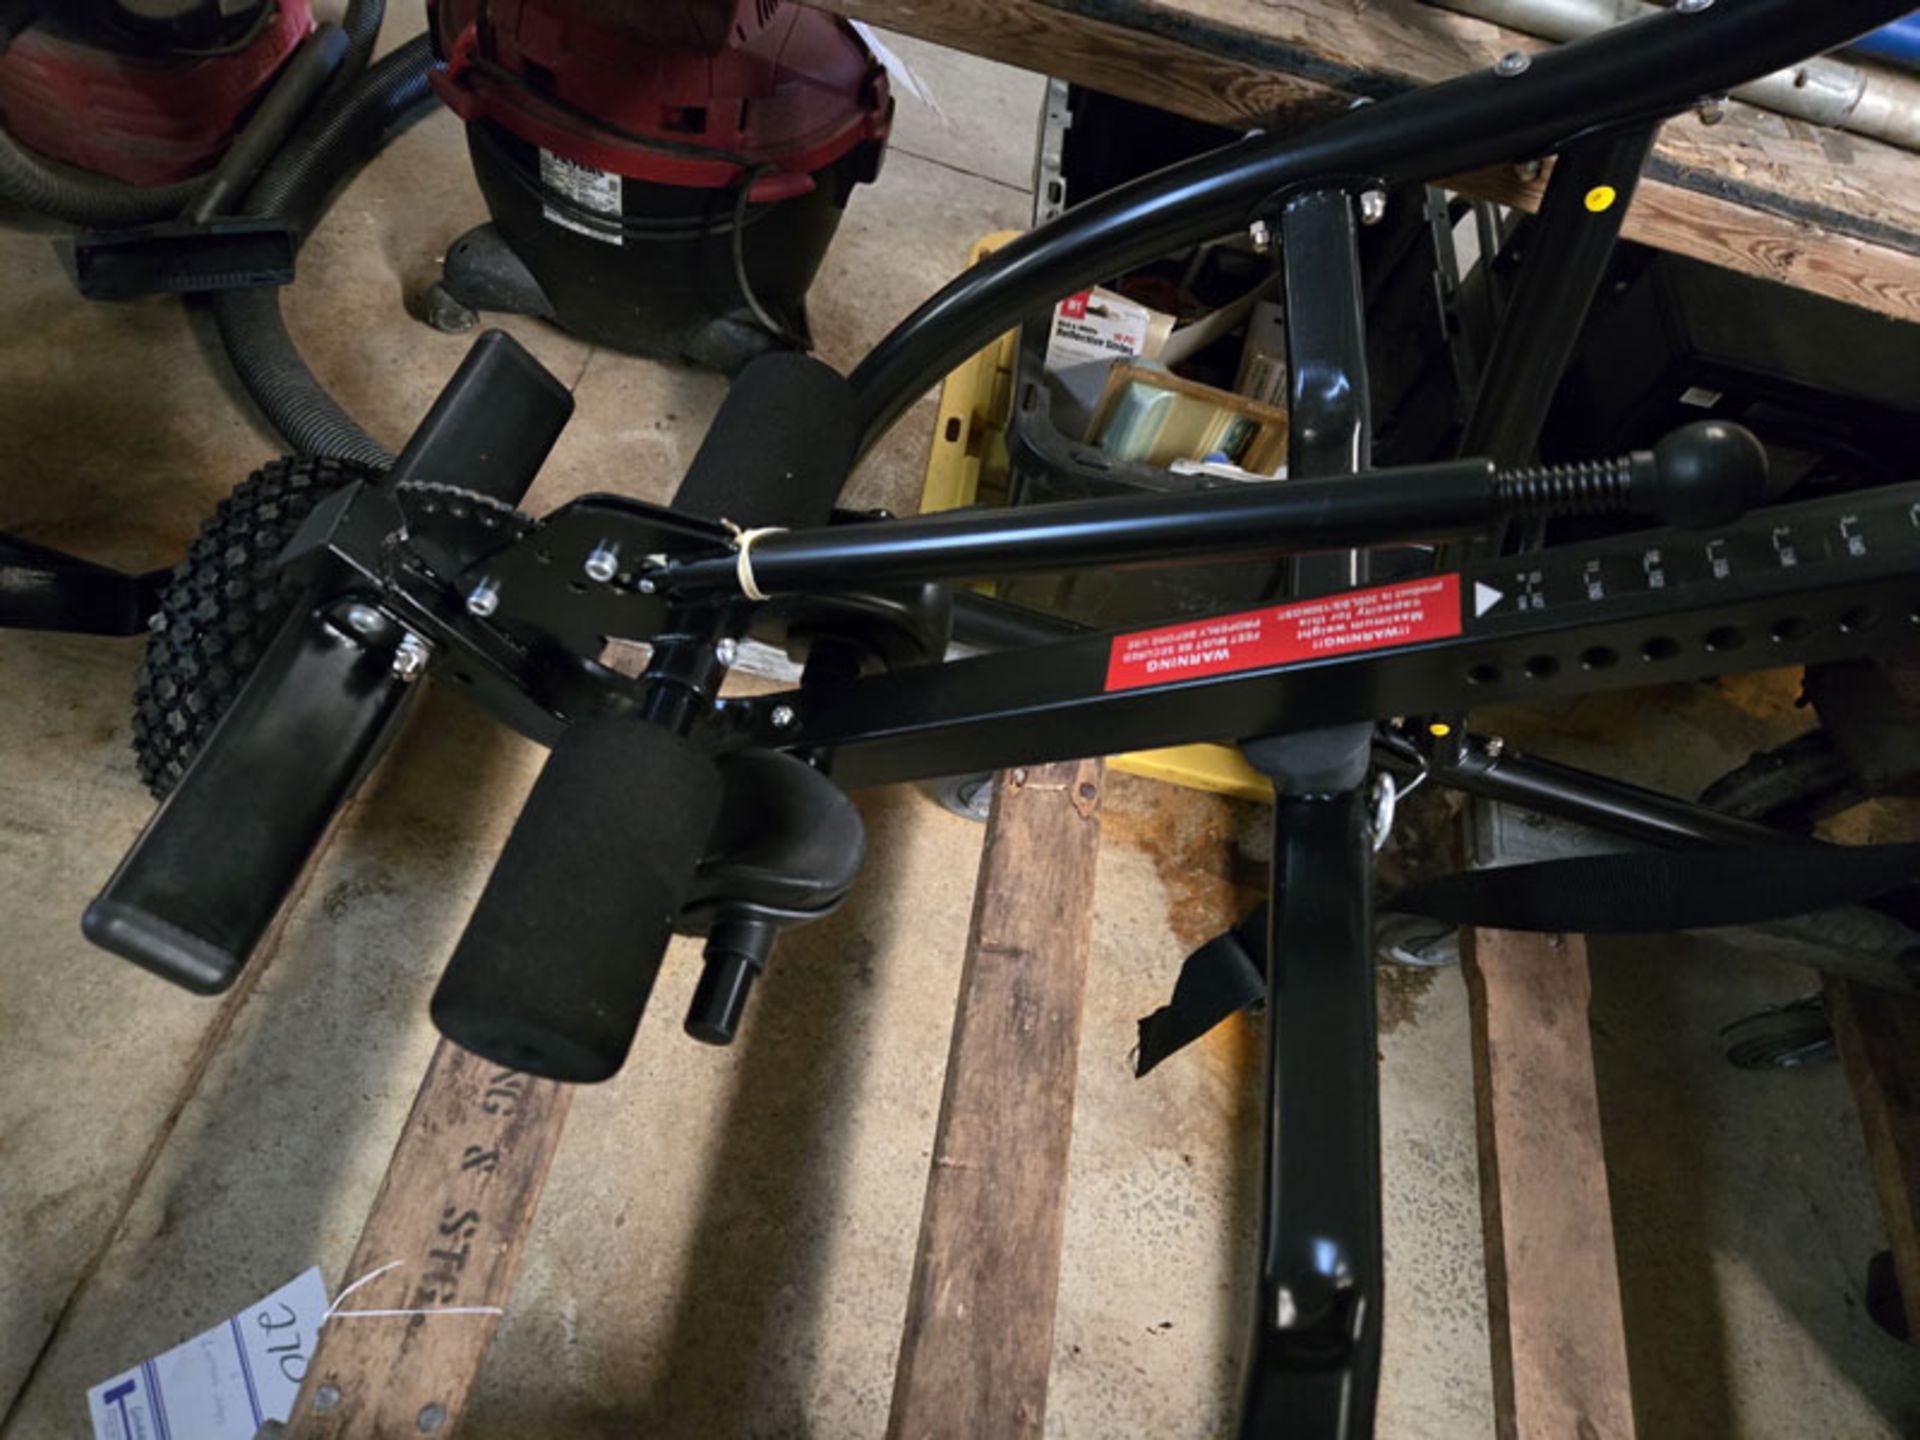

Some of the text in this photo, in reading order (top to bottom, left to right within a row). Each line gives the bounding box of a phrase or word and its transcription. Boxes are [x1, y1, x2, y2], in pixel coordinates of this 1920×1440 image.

[1056, 328, 1104, 346] Reflective
[1394, 581, 1444, 598] product
[1299, 598, 1422, 627] capacity for this
[1199, 618, 1261, 637] PROPERLY
[1296, 611, 1424, 640] Maximum weight
[1122, 631, 1261, 663] FEET MUST BE SECURED
[1151, 629, 1197, 646] BEFORE
[1146, 648, 1230, 673] WARNING
